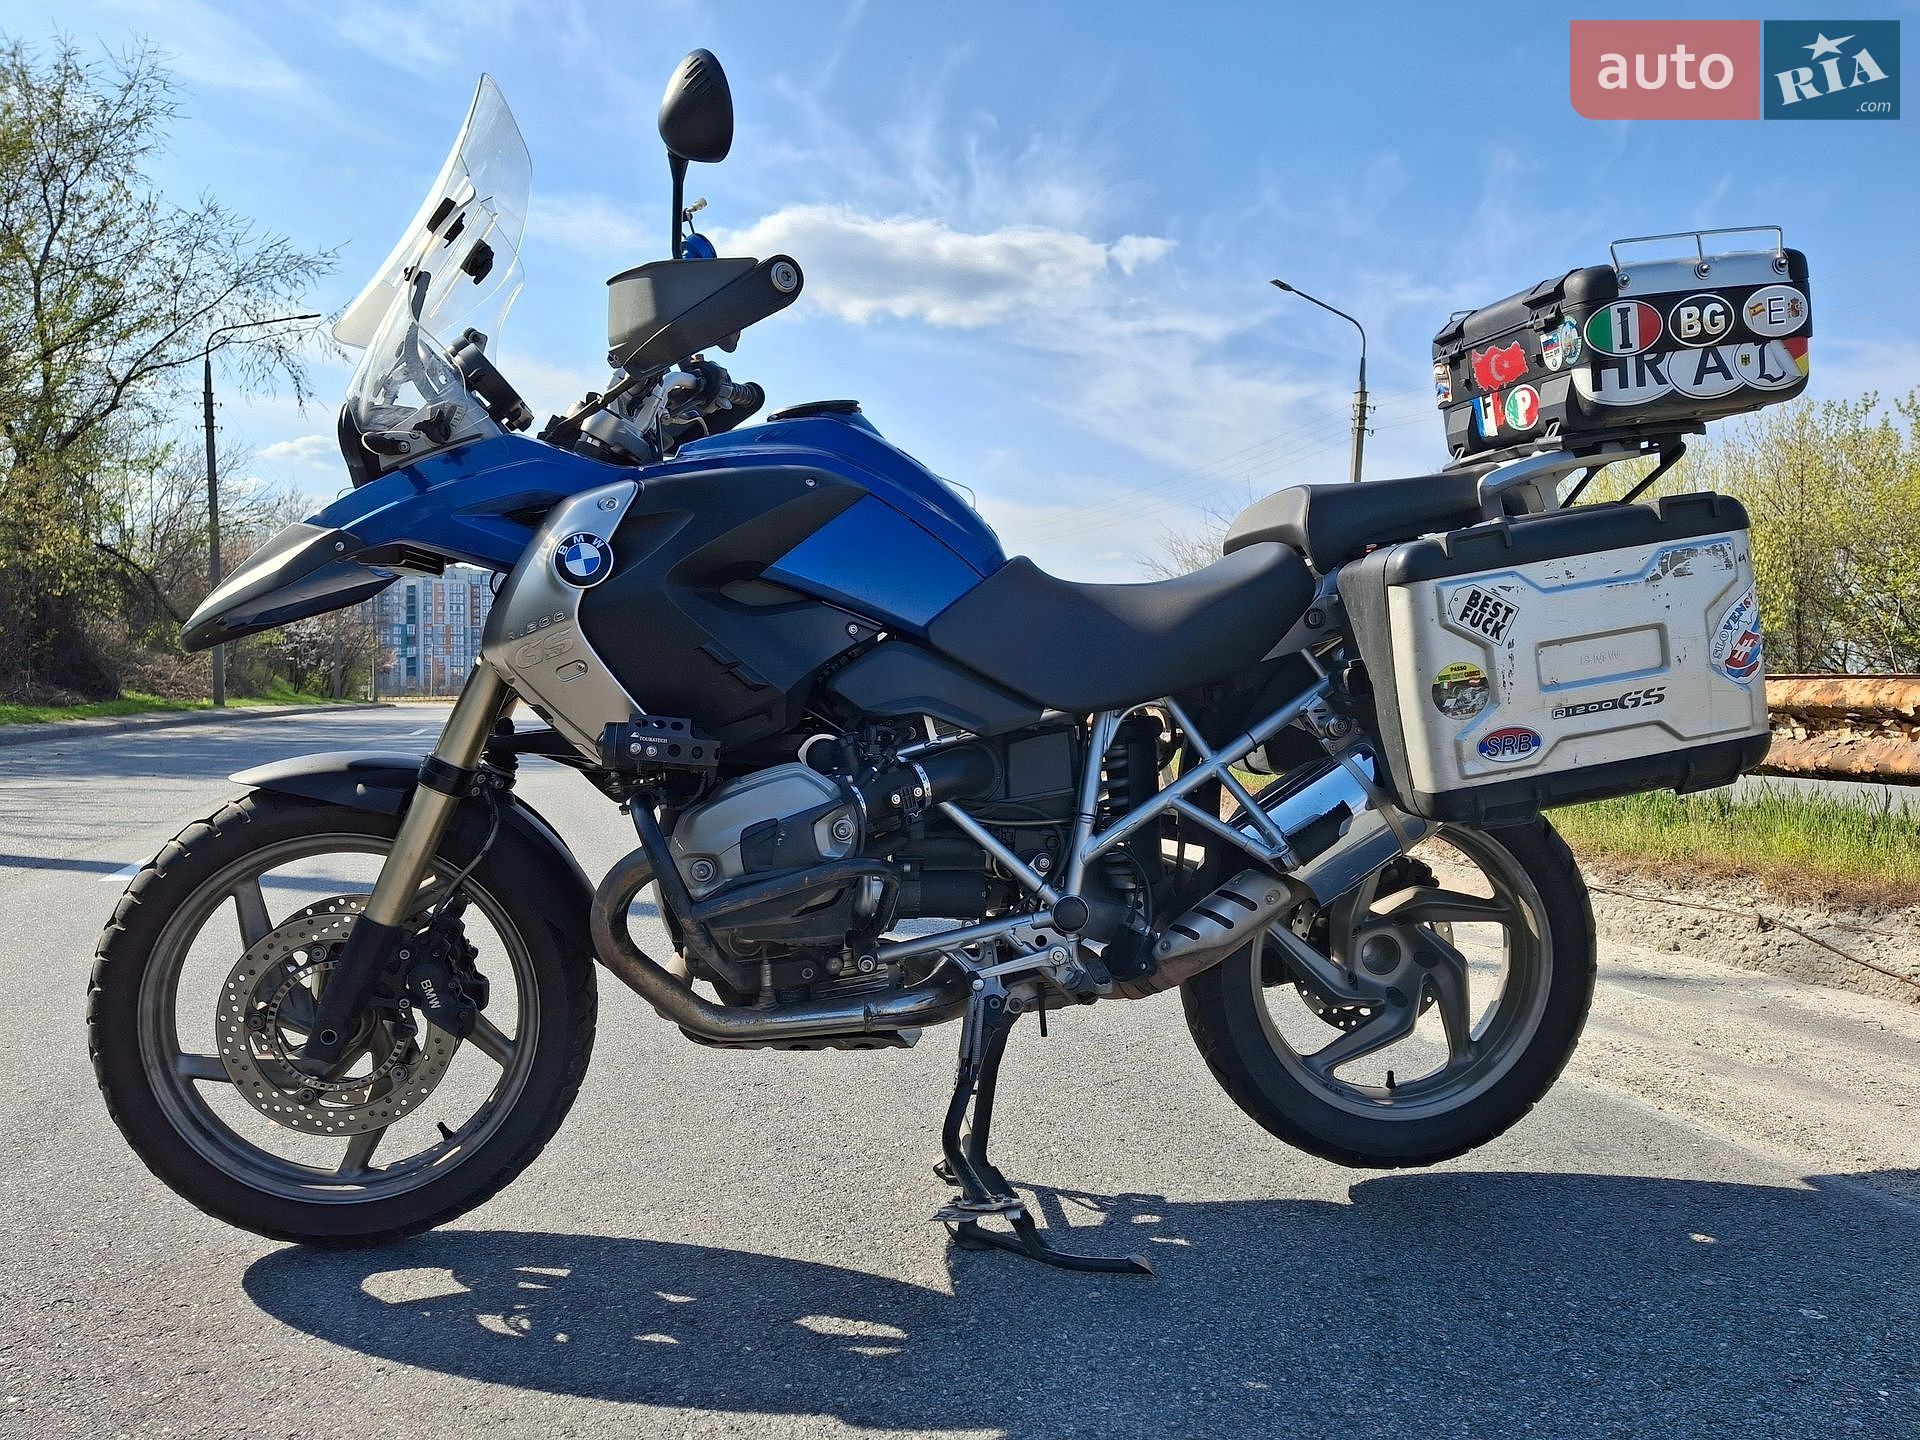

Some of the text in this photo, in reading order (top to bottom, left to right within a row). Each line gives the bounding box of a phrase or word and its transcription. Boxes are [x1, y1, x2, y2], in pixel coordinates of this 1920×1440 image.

[1617, 306, 1633, 350] I
[1680, 303, 1726, 338] BG
[1767, 296, 1786, 325] E
[1591, 351, 1668, 393] HR
[1693, 347, 1734, 386] A
[1515, 390, 1532, 426] P
[557, 535, 605, 556] BMW
[1458, 605, 1507, 640] FUCK
[1466, 589, 1514, 624] BEST
[1486, 733, 1533, 758] SRB
[420, 978, 442, 1010] BMW
